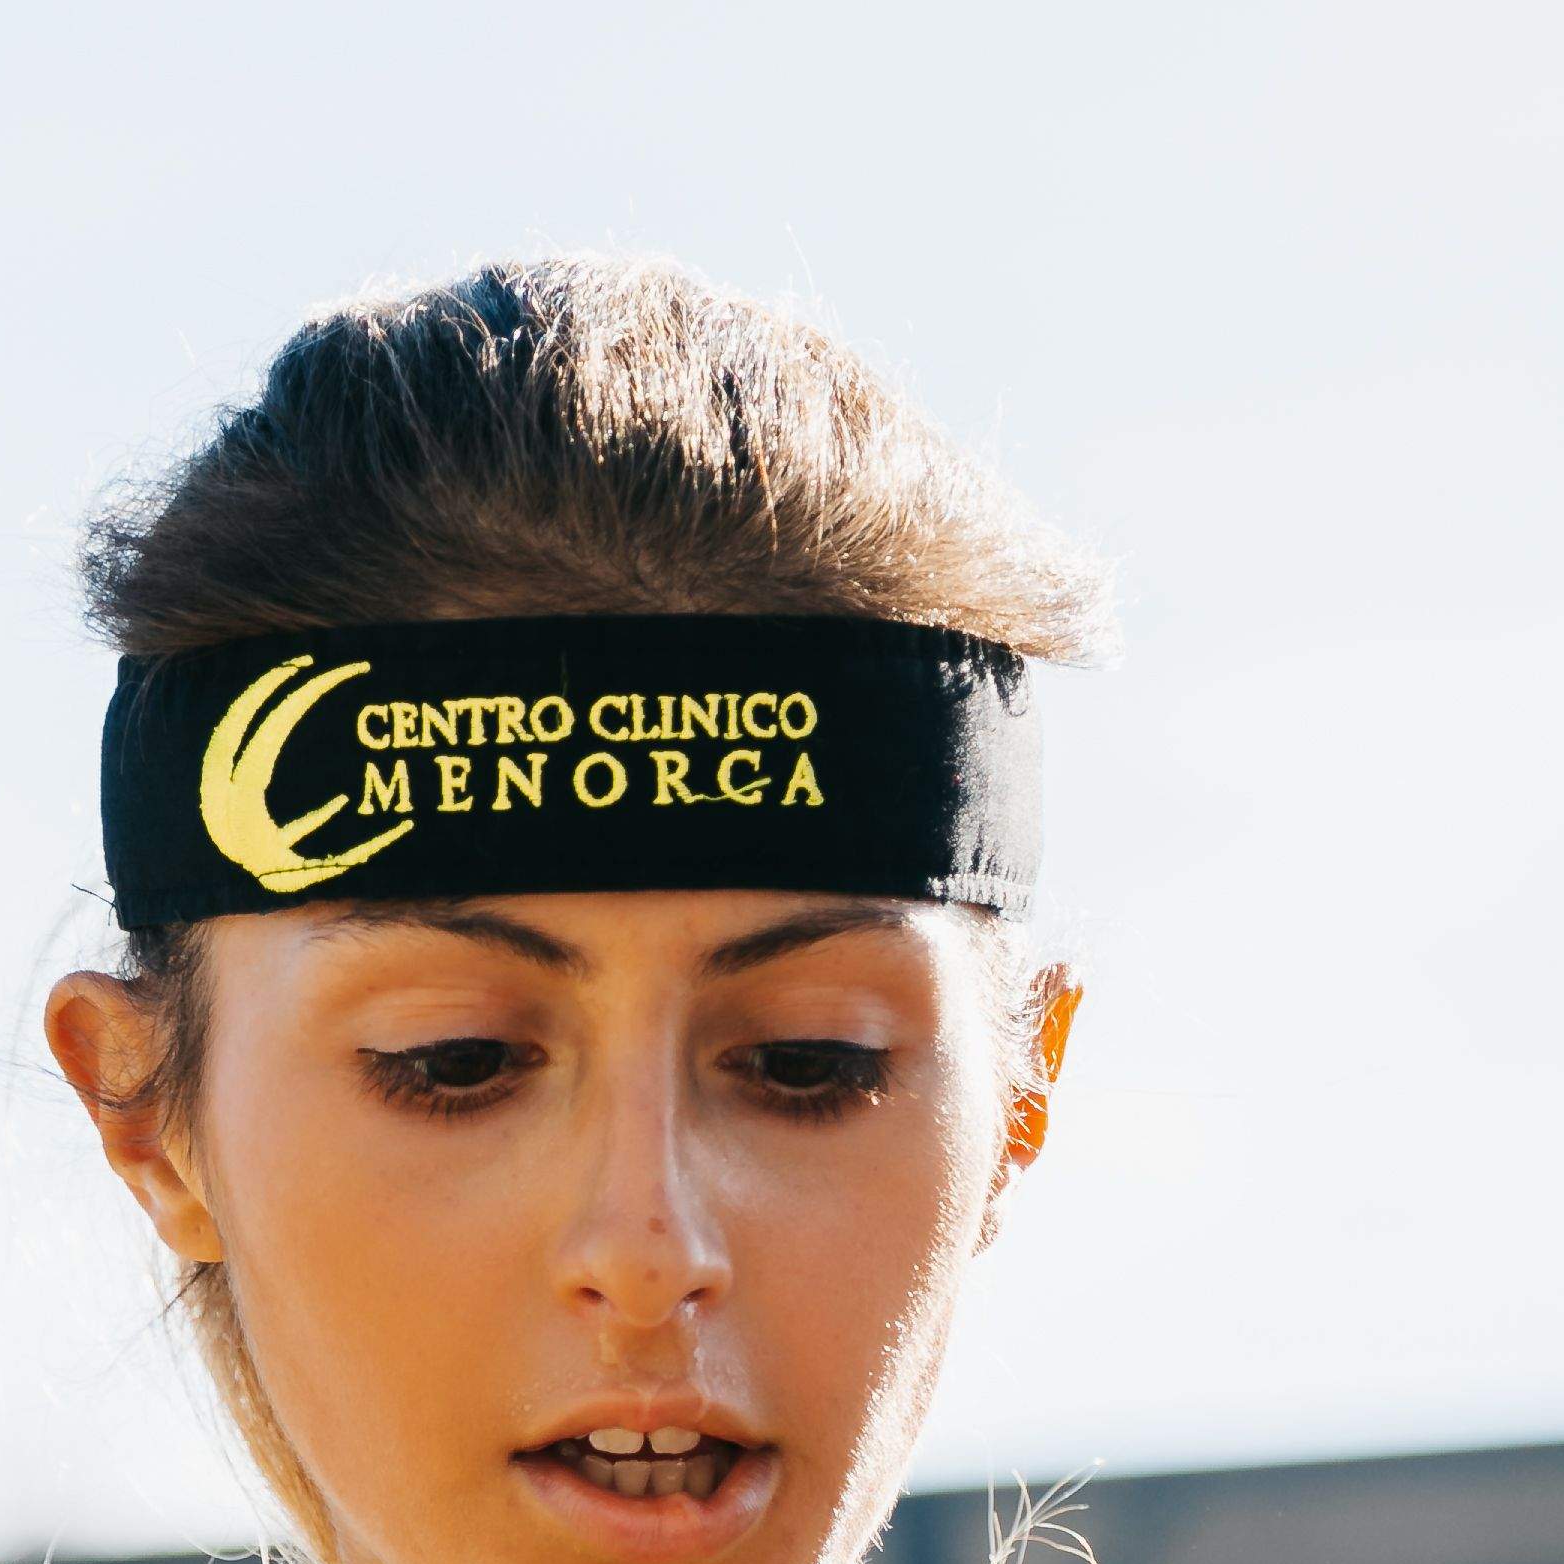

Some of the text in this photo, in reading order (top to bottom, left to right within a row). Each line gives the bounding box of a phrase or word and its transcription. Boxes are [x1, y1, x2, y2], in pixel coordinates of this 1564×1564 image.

[356, 691, 819, 752] CENTRO CLINICO
[357, 751, 825, 815] MENORCA
